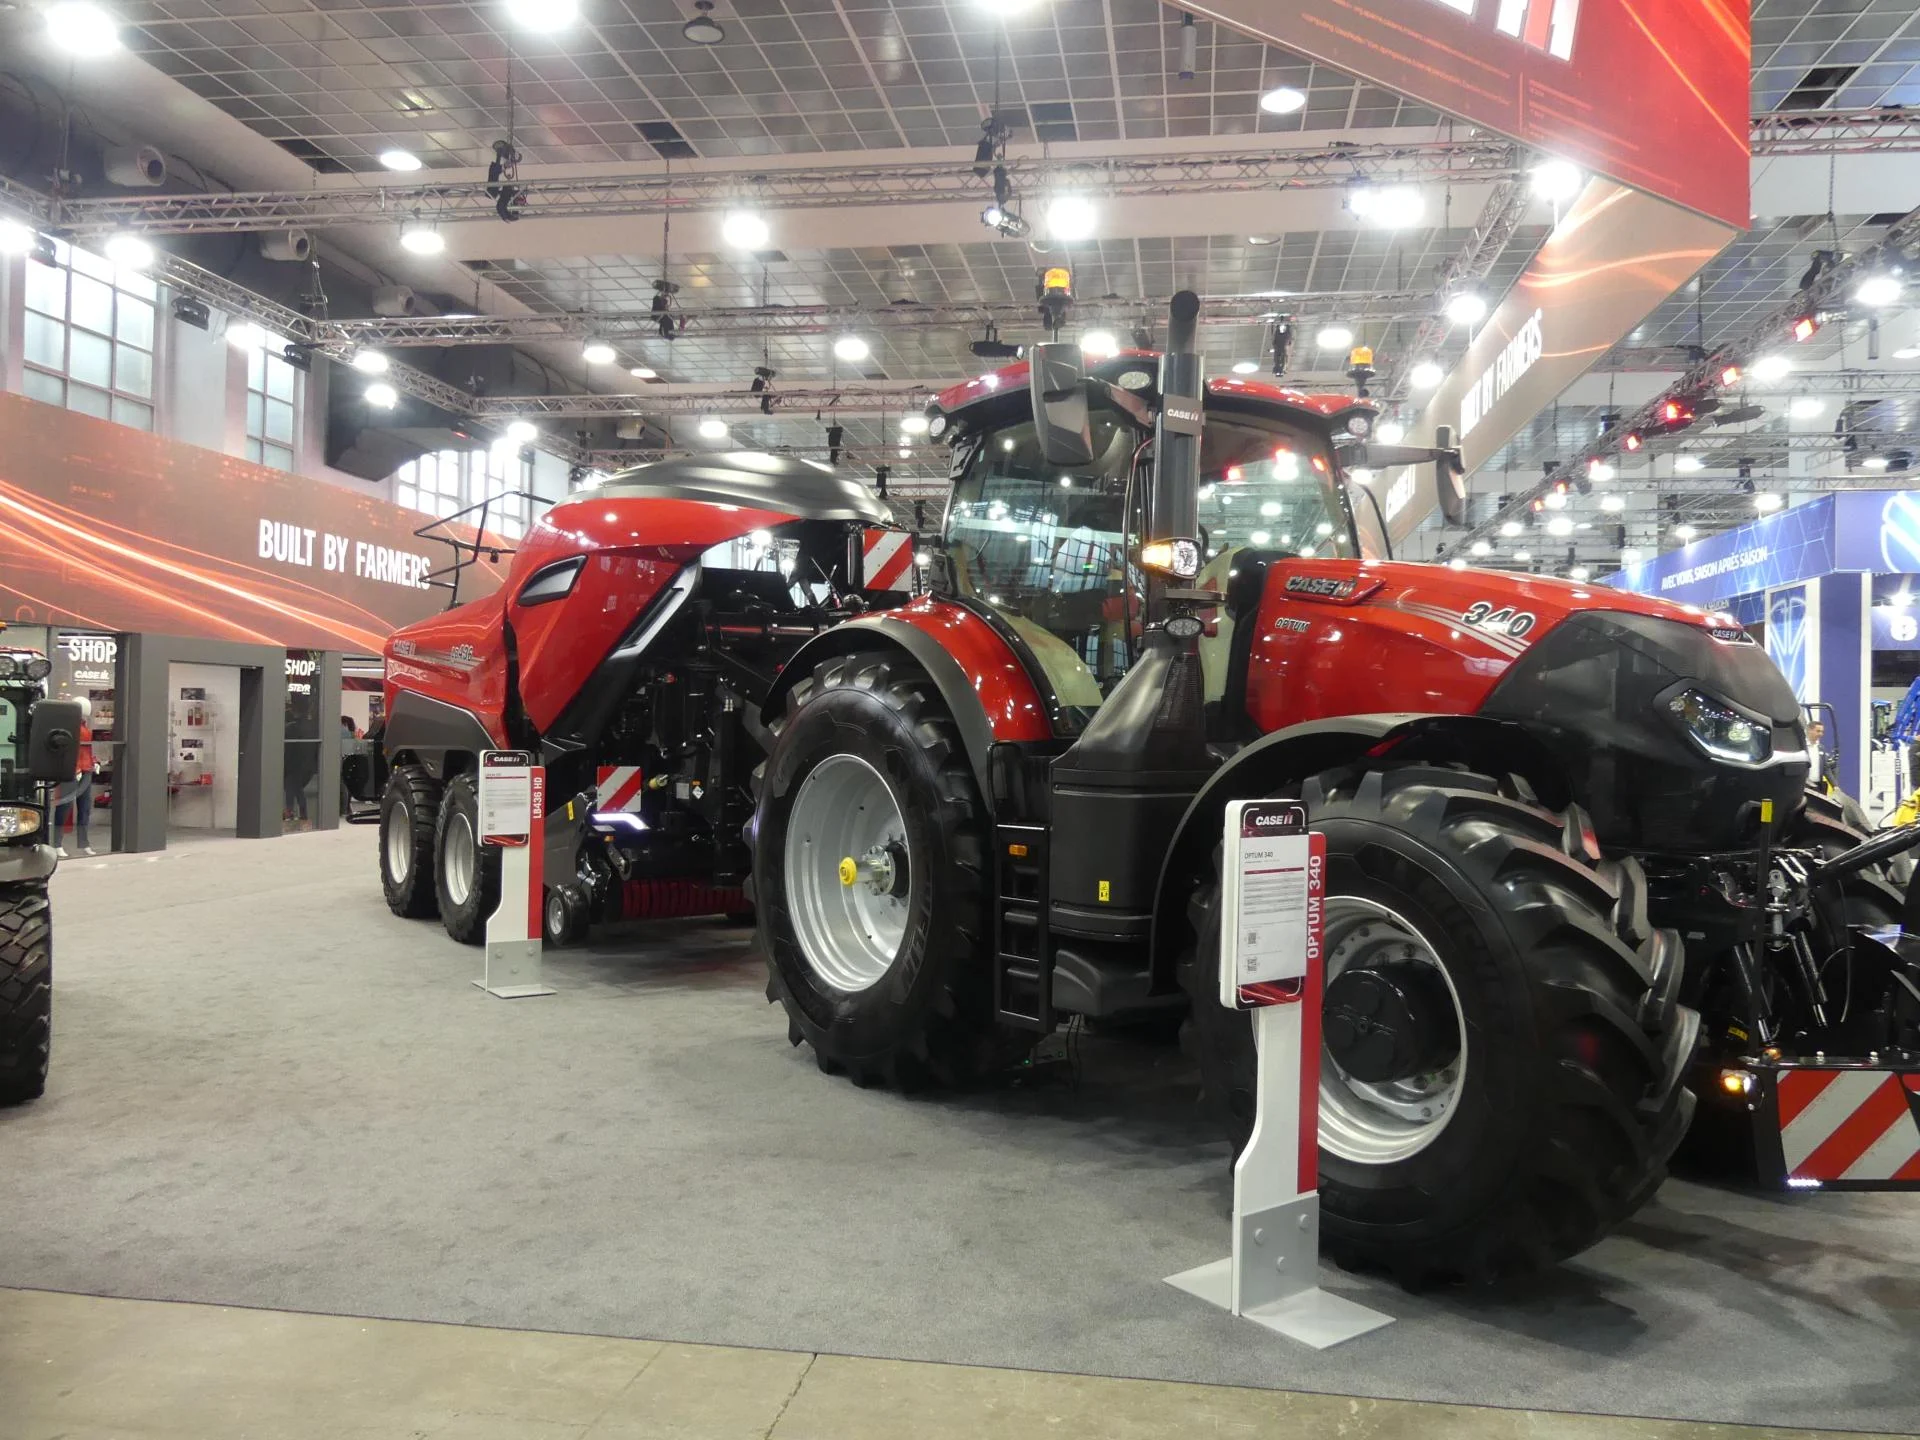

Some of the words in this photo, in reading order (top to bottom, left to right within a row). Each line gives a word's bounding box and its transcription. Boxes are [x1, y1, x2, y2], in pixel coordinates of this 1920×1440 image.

[1167, 408, 1191, 420] CASE
[258, 518, 317, 567] BUILT
[323, 533, 349, 573] BY
[356, 541, 431, 590] FARMERS
[1694, 560, 1718, 581] SAISON
[1740, 546, 1768, 568] SAISON
[1285, 575, 1336, 594] CASE
[1275, 617, 1311, 633] OPTUM
[1462, 601, 1536, 637] 340
[74, 670, 100, 680] CASE
[287, 683, 311, 693] STEYR
[533, 777, 543, 789] HD
[533, 791, 542, 819] LB436
[1255, 815, 1283, 826] CASE
[1244, 851, 1264, 860] OPTUM
[1309, 855, 1321, 890] 340
[1307, 896, 1320, 959] OPTUM
